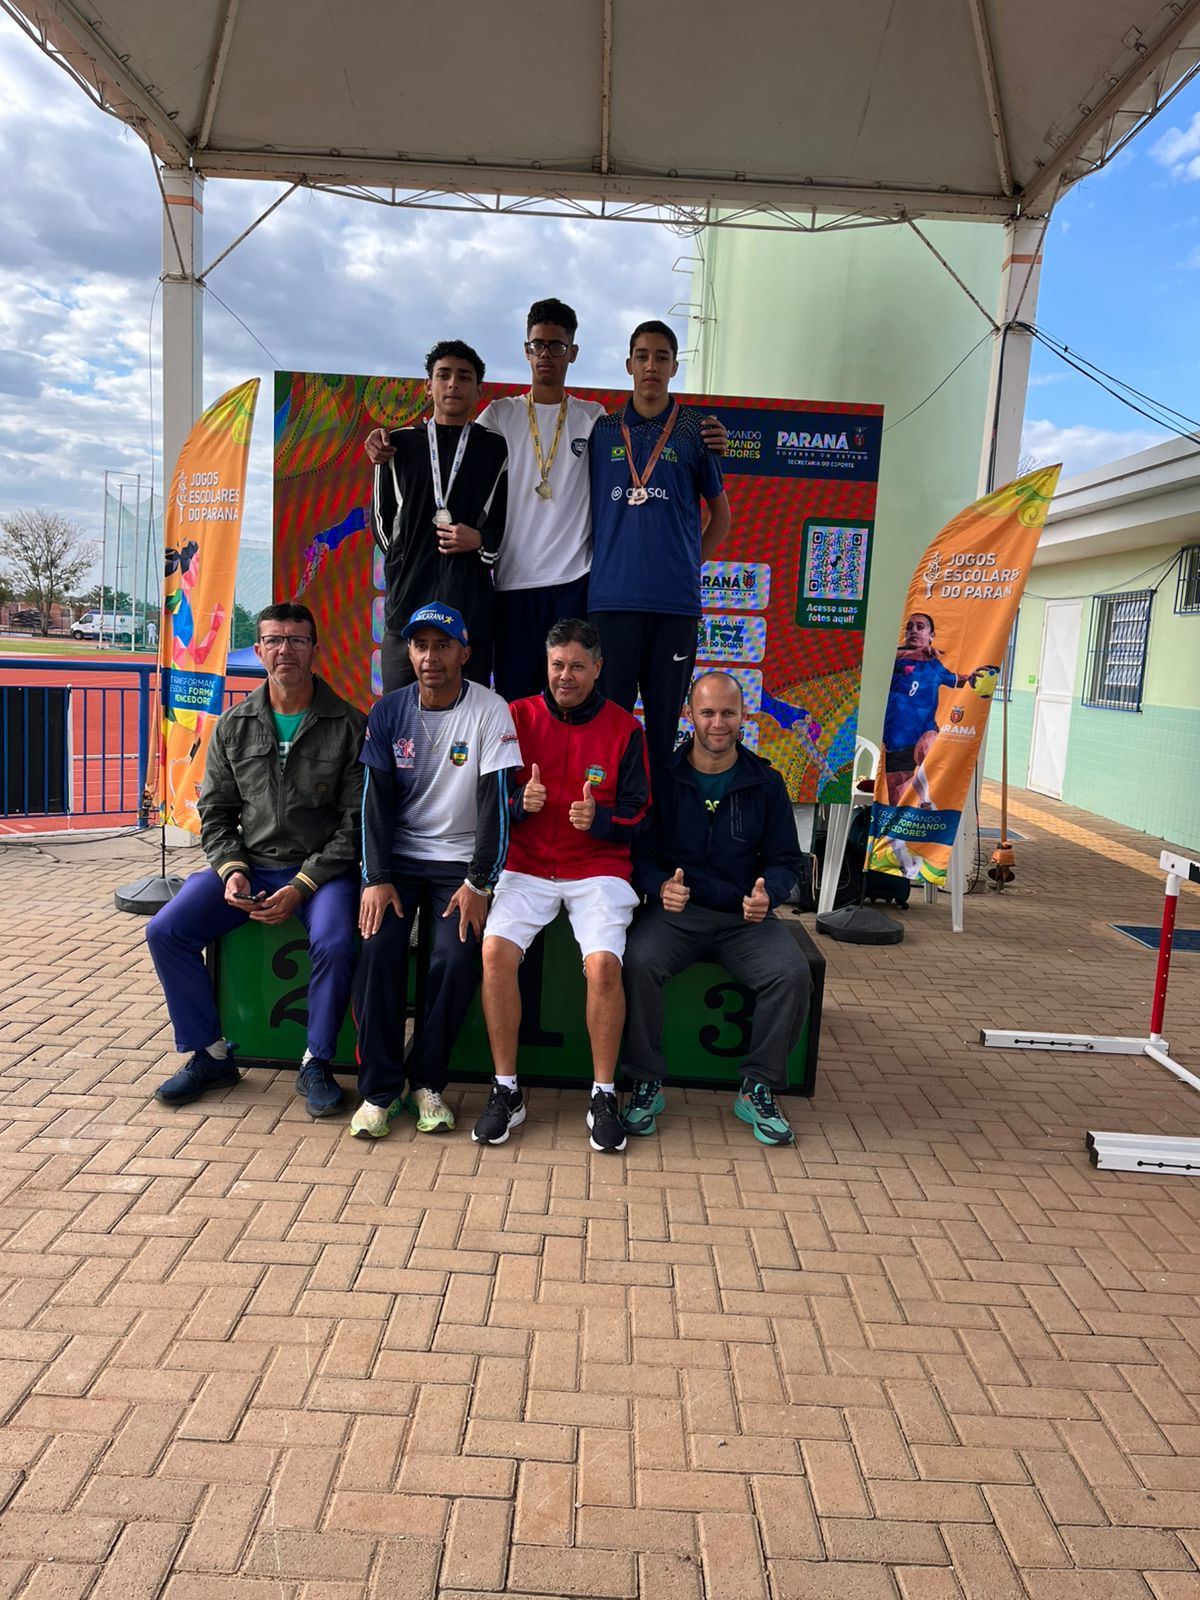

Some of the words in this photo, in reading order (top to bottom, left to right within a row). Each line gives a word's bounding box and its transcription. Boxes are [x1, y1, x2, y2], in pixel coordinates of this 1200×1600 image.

[776, 430, 849, 449] PARANÁ
[190, 472, 219, 487] JOGOS
[189, 488, 240, 505] ESCOLARES
[188, 508, 200, 522] DO
[946, 552, 997, 567] JOGOS
[941, 585, 961, 598] DO
[806, 603, 837, 612] Acesse
[838, 606, 858, 614] suas
[808, 613, 831, 623] fotos
[832, 615, 855, 625] aqui!
[908, 681, 919, 697] 8
[898, 818, 947, 830] FORMANDO
[699, 981, 755, 1058] 3
